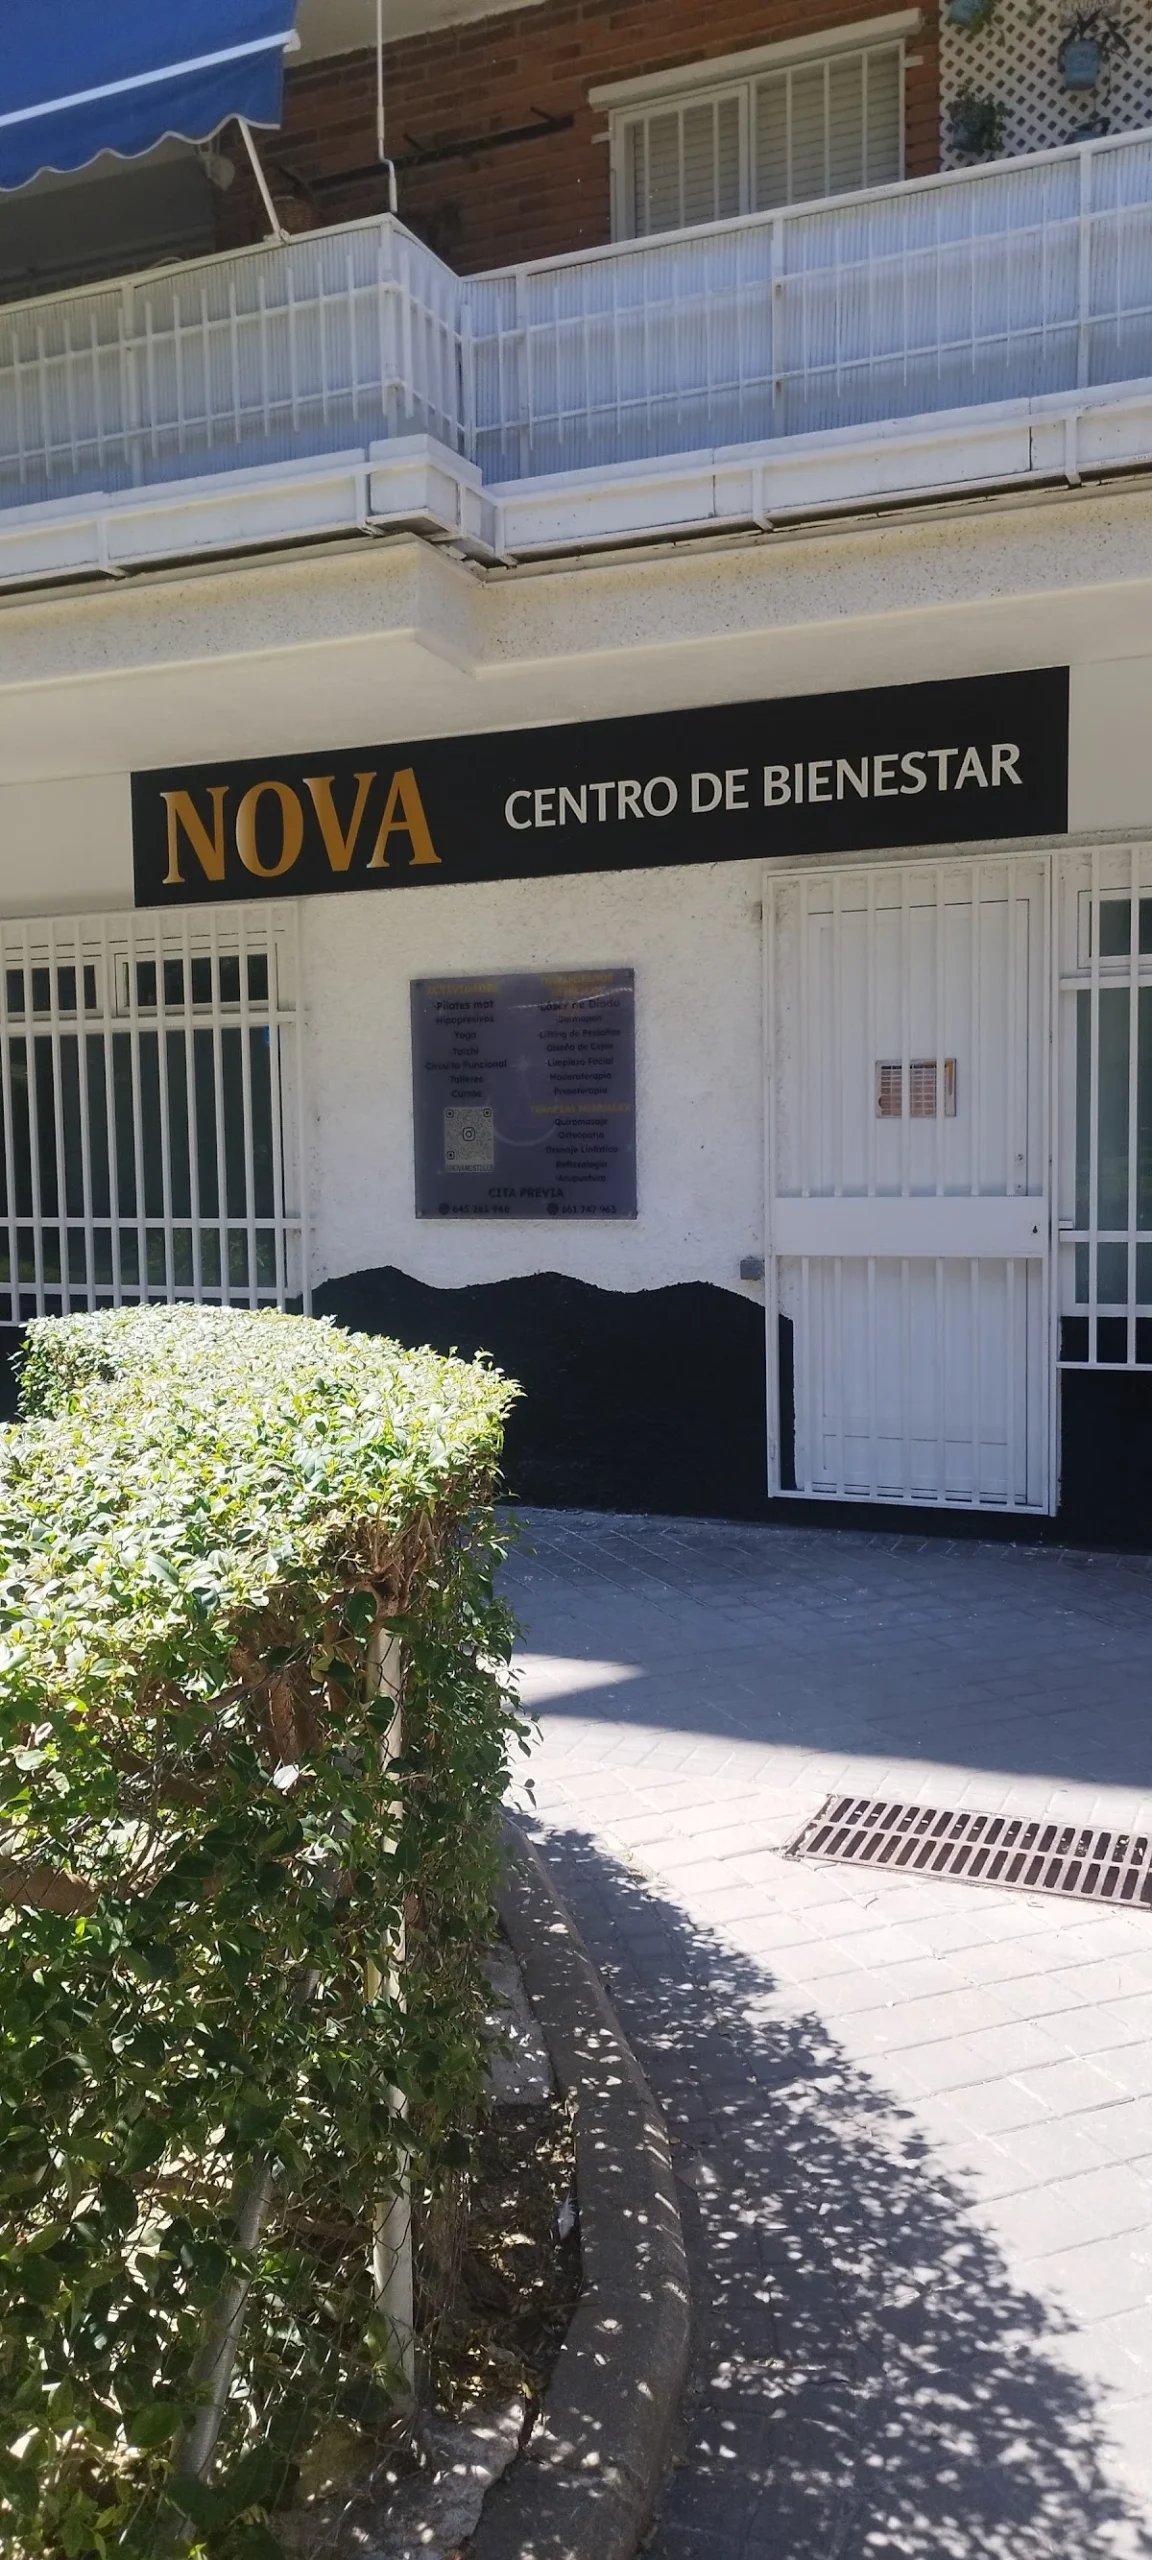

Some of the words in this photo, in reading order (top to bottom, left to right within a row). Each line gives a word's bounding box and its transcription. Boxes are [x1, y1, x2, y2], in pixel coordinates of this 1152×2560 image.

[504, 776, 678, 829] CENTRO
[691, 769, 749, 813] DE
[763, 742, 1023, 806] BIENESTAR
[159, 767, 442, 884] NOVA
[454, 1031, 477, 1041] Yoga
[488, 1187, 517, 1198] CITA
[519, 1187, 565, 1198] PREVIA
